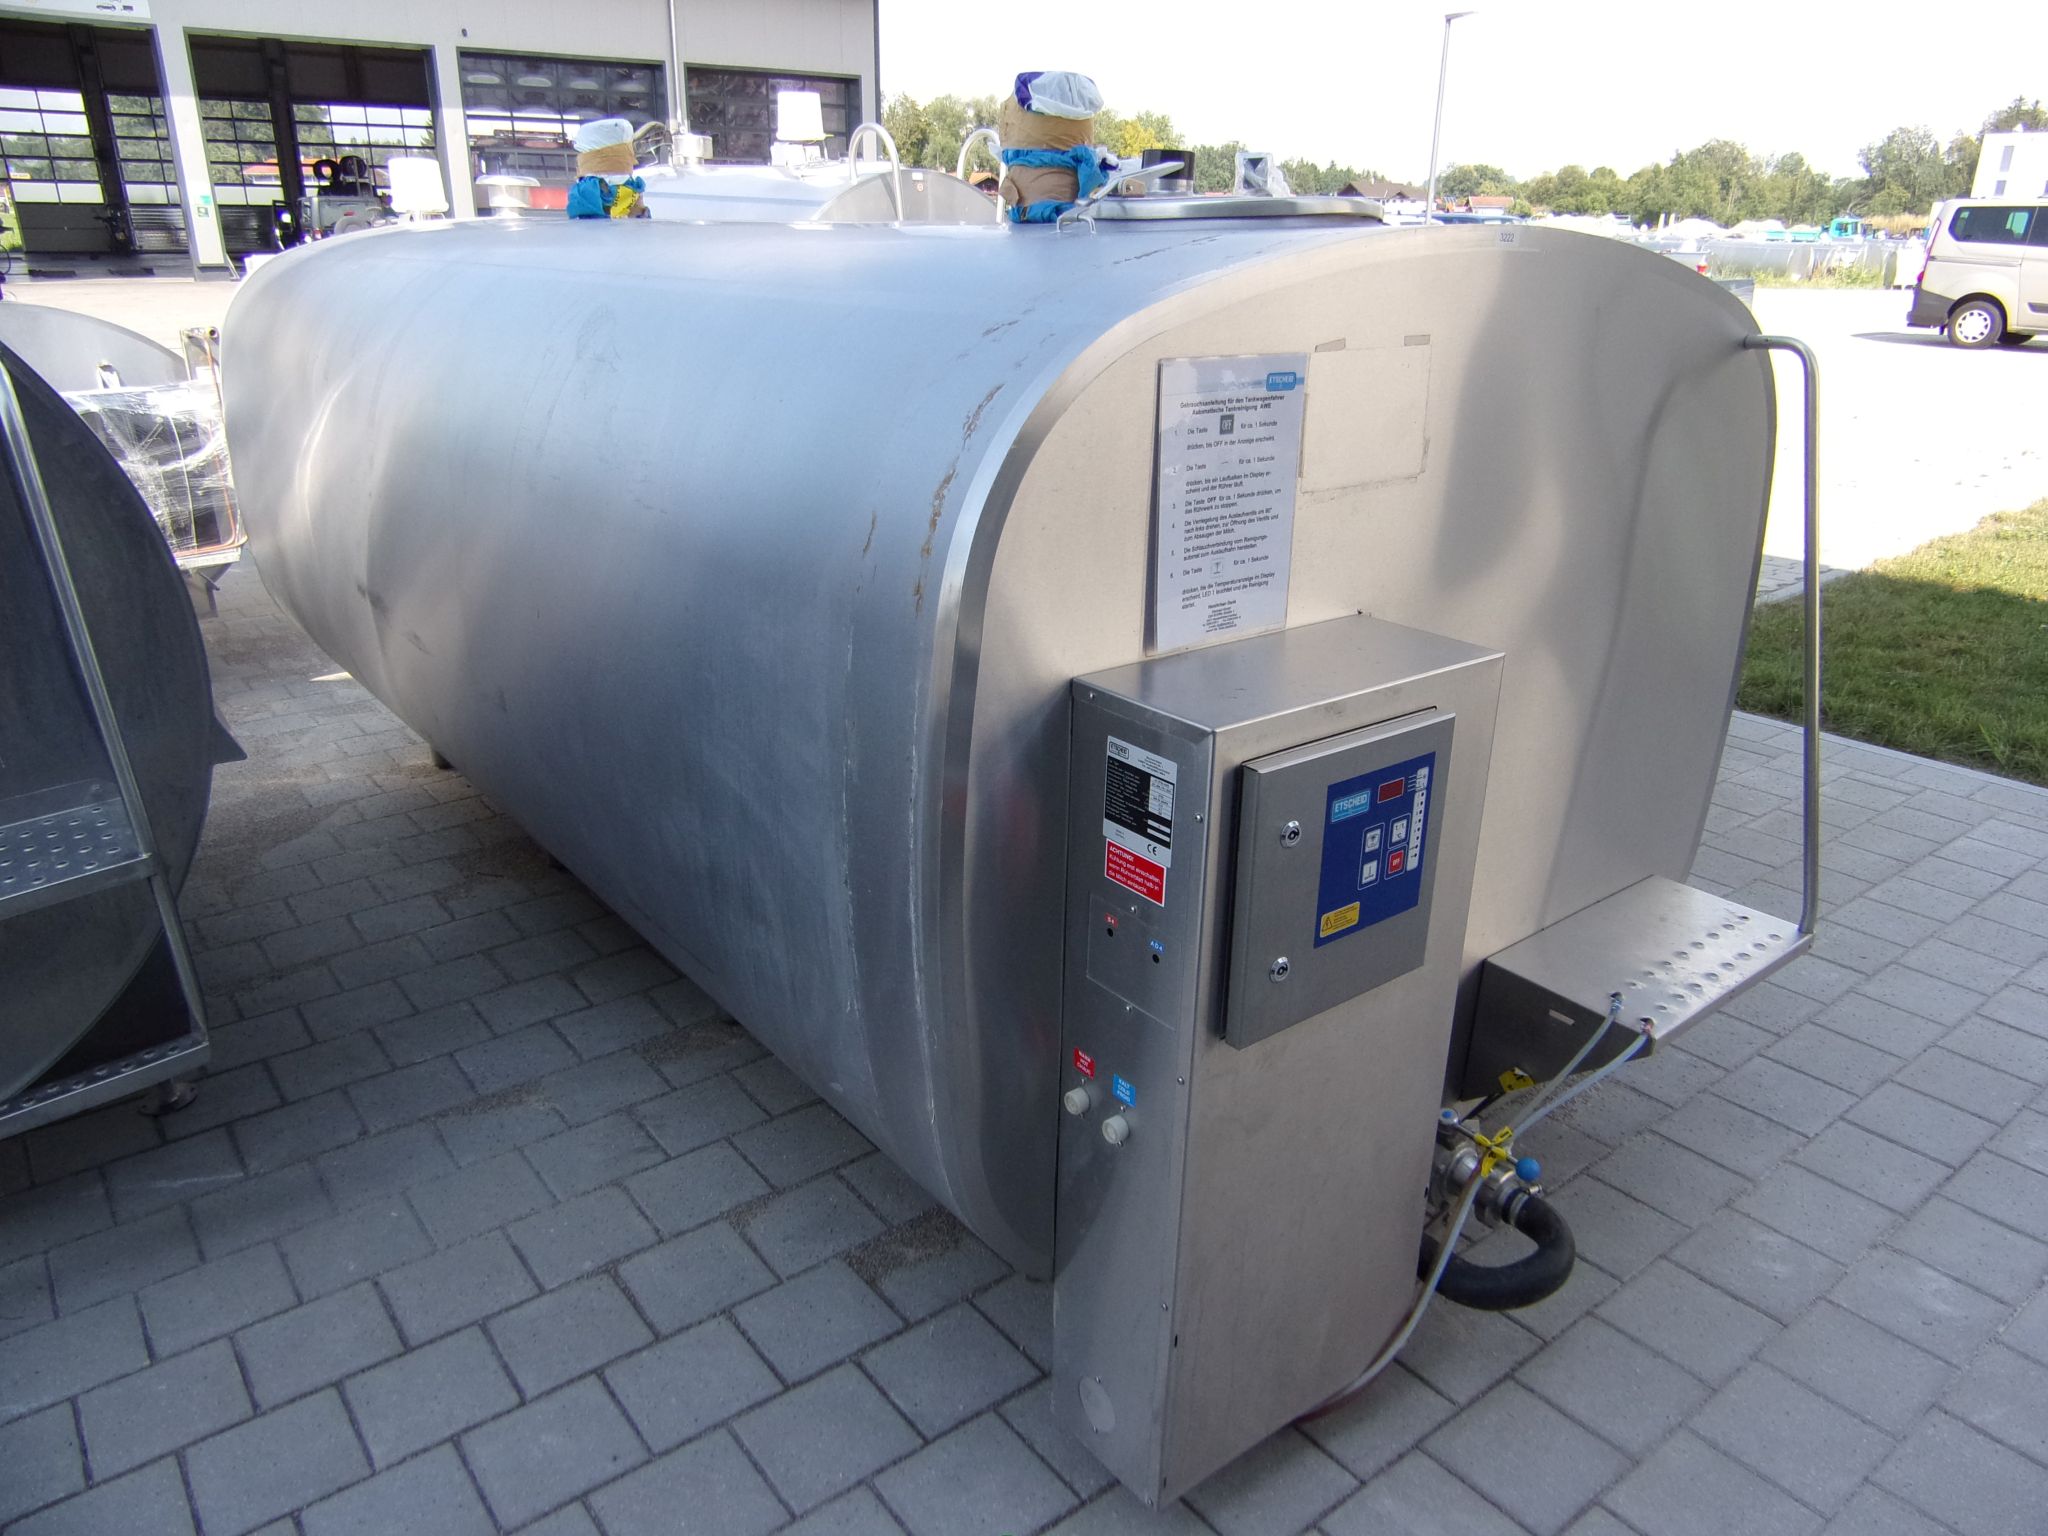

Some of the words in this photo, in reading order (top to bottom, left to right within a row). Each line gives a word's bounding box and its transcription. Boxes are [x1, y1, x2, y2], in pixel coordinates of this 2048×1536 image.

[1194, 505, 1213, 513] Rührwerk
[1194, 531, 1214, 540] Absaugen
[1251, 555, 1268, 563] Sekunde
[1335, 794, 1367, 813] ETSCHEID
